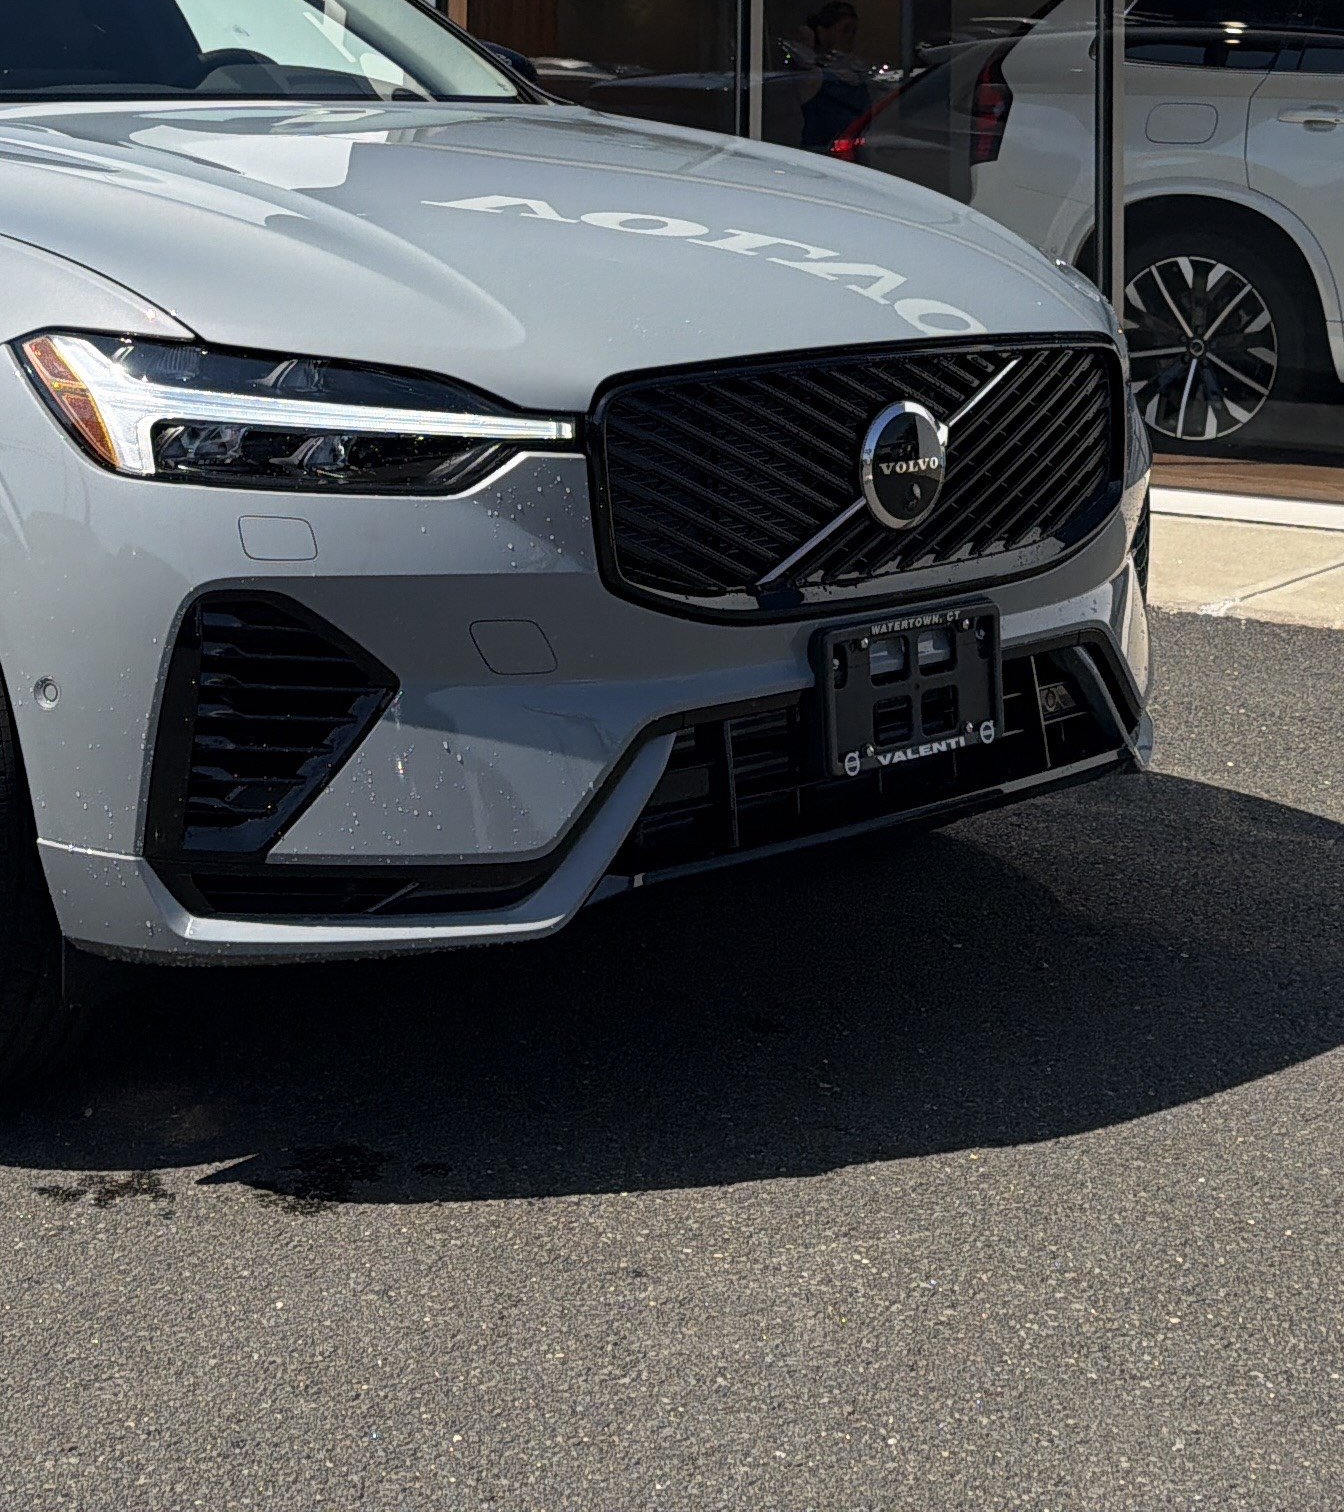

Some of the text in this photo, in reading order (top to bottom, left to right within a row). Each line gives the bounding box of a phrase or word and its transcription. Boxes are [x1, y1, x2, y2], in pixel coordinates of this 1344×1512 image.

[879, 456, 939, 475] VOLVO
[871, 610, 961, 635] WATERTOWN, CT
[877, 736, 966, 766] VALENTI
